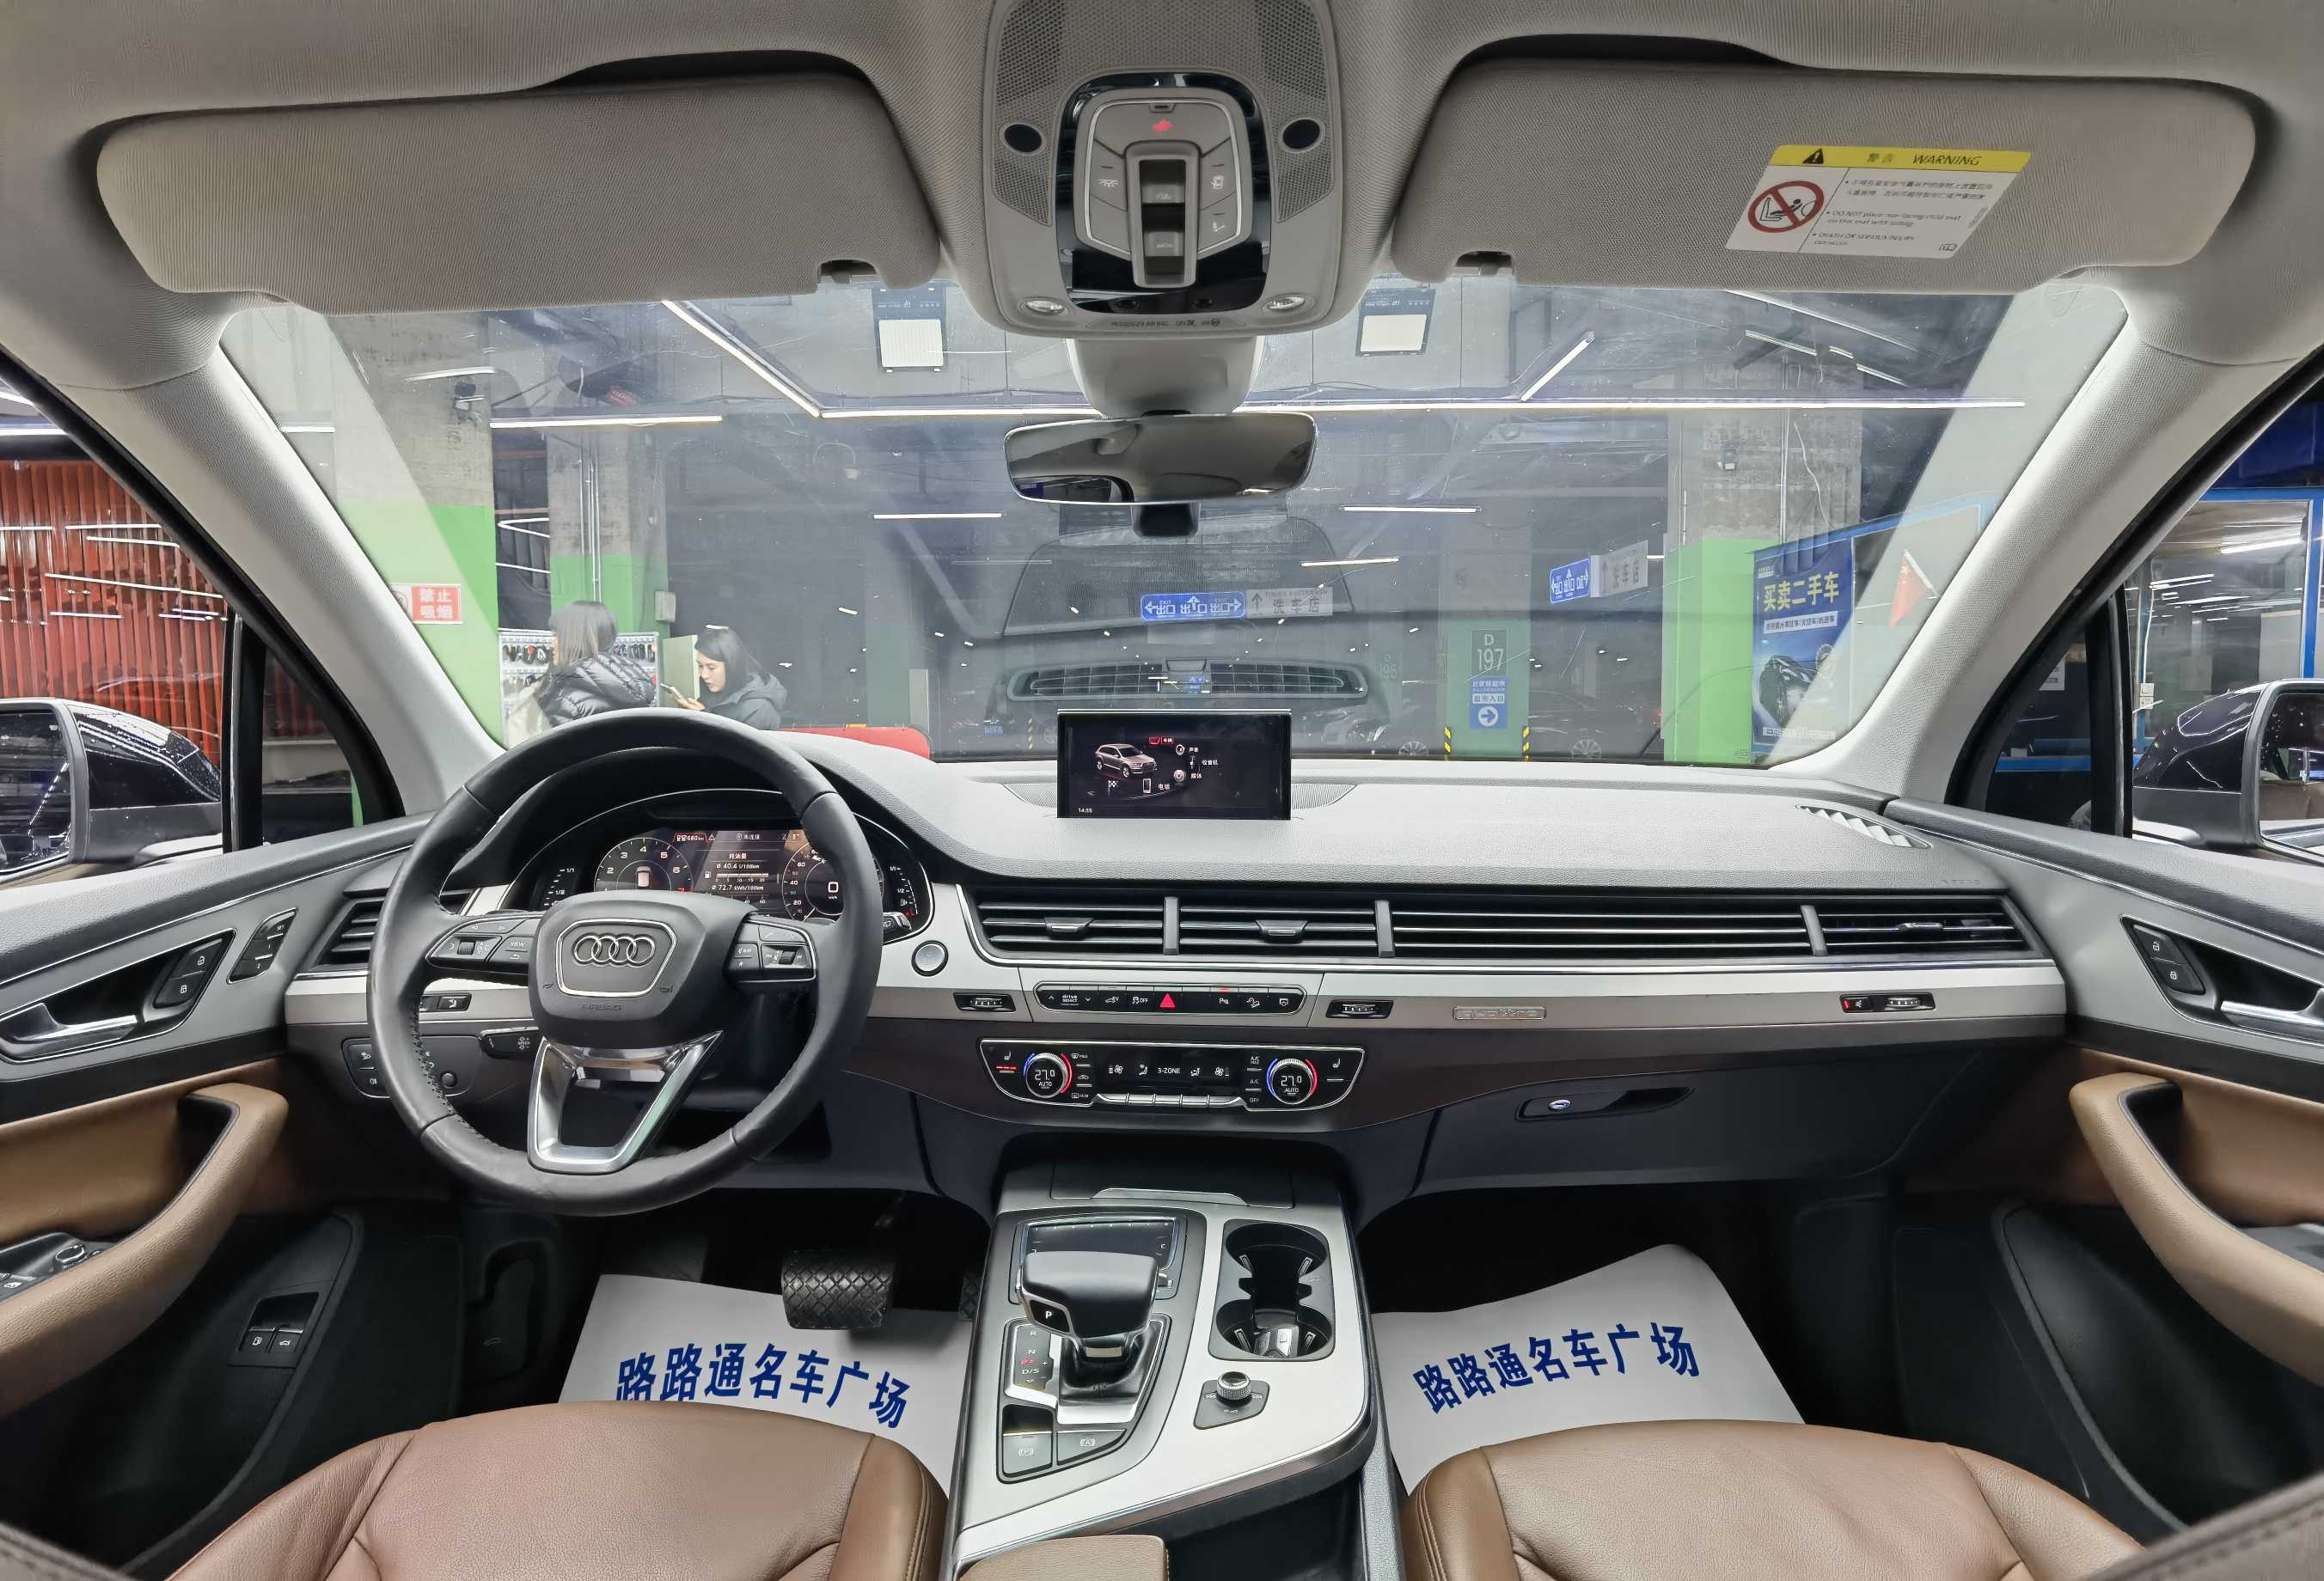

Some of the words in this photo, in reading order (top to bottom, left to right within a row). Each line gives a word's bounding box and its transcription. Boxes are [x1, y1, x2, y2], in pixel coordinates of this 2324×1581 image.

[1912, 154, 1982, 166] WARNING
[419, 588, 453, 603] 禁止
[1764, 571, 1839, 612] 买卖二手车
[419, 605, 454, 620] 吸烟
[1156, 605, 1176, 615] 出口
[1180, 604, 1208, 614] 出口
[1210, 602, 1230, 613] 出口
[1484, 634, 1495, 646] D
[1477, 648, 1504, 671] 197
[828, 881, 839, 894] 0
[1045, 1310, 1053, 1319] P
[1412, 1322, 1700, 1414] 路路通名车广场
[615, 1342, 911, 1429] 路路通名车广场
